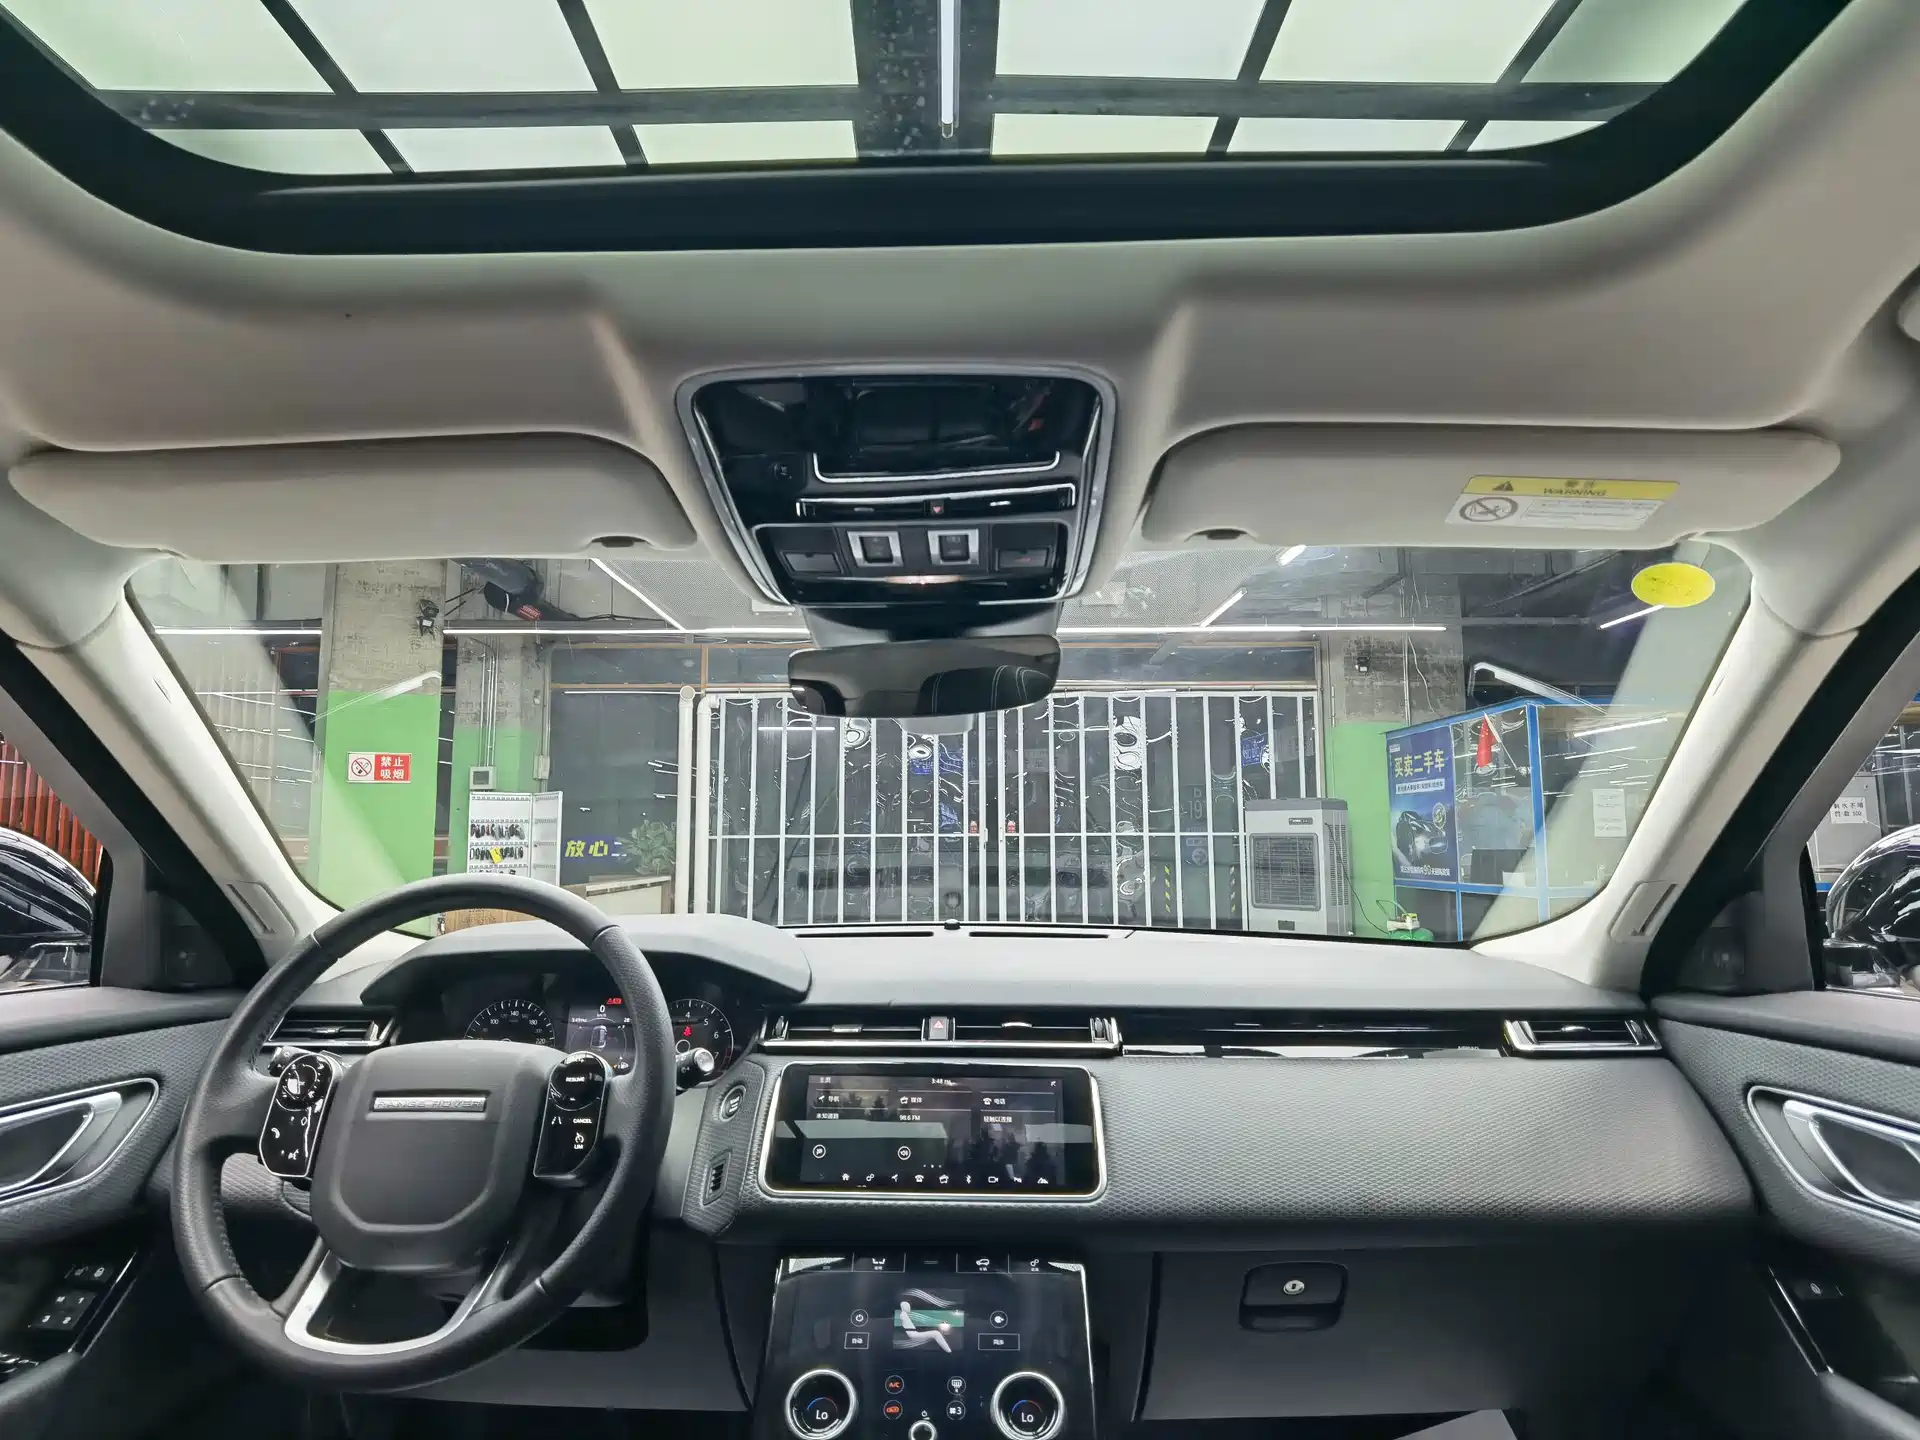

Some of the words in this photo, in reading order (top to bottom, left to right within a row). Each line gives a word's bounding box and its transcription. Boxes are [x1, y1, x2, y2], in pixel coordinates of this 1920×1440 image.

[381, 756, 404, 767] 禁止
[1394, 749, 1445, 778] 买卖二手车
[380, 769, 405, 780] 吸烟
[564, 840, 609, 857] 放心
[600, 1004, 606, 1013] 0
[703, 1018, 709, 1026] 5
[713, 1031, 719, 1039] 6
[431, 1099, 484, 1109] ROVER
[816, 1409, 829, 1420] Lo
[956, 1406, 962, 1415] 3
[1021, 1412, 1034, 1423] Lo
